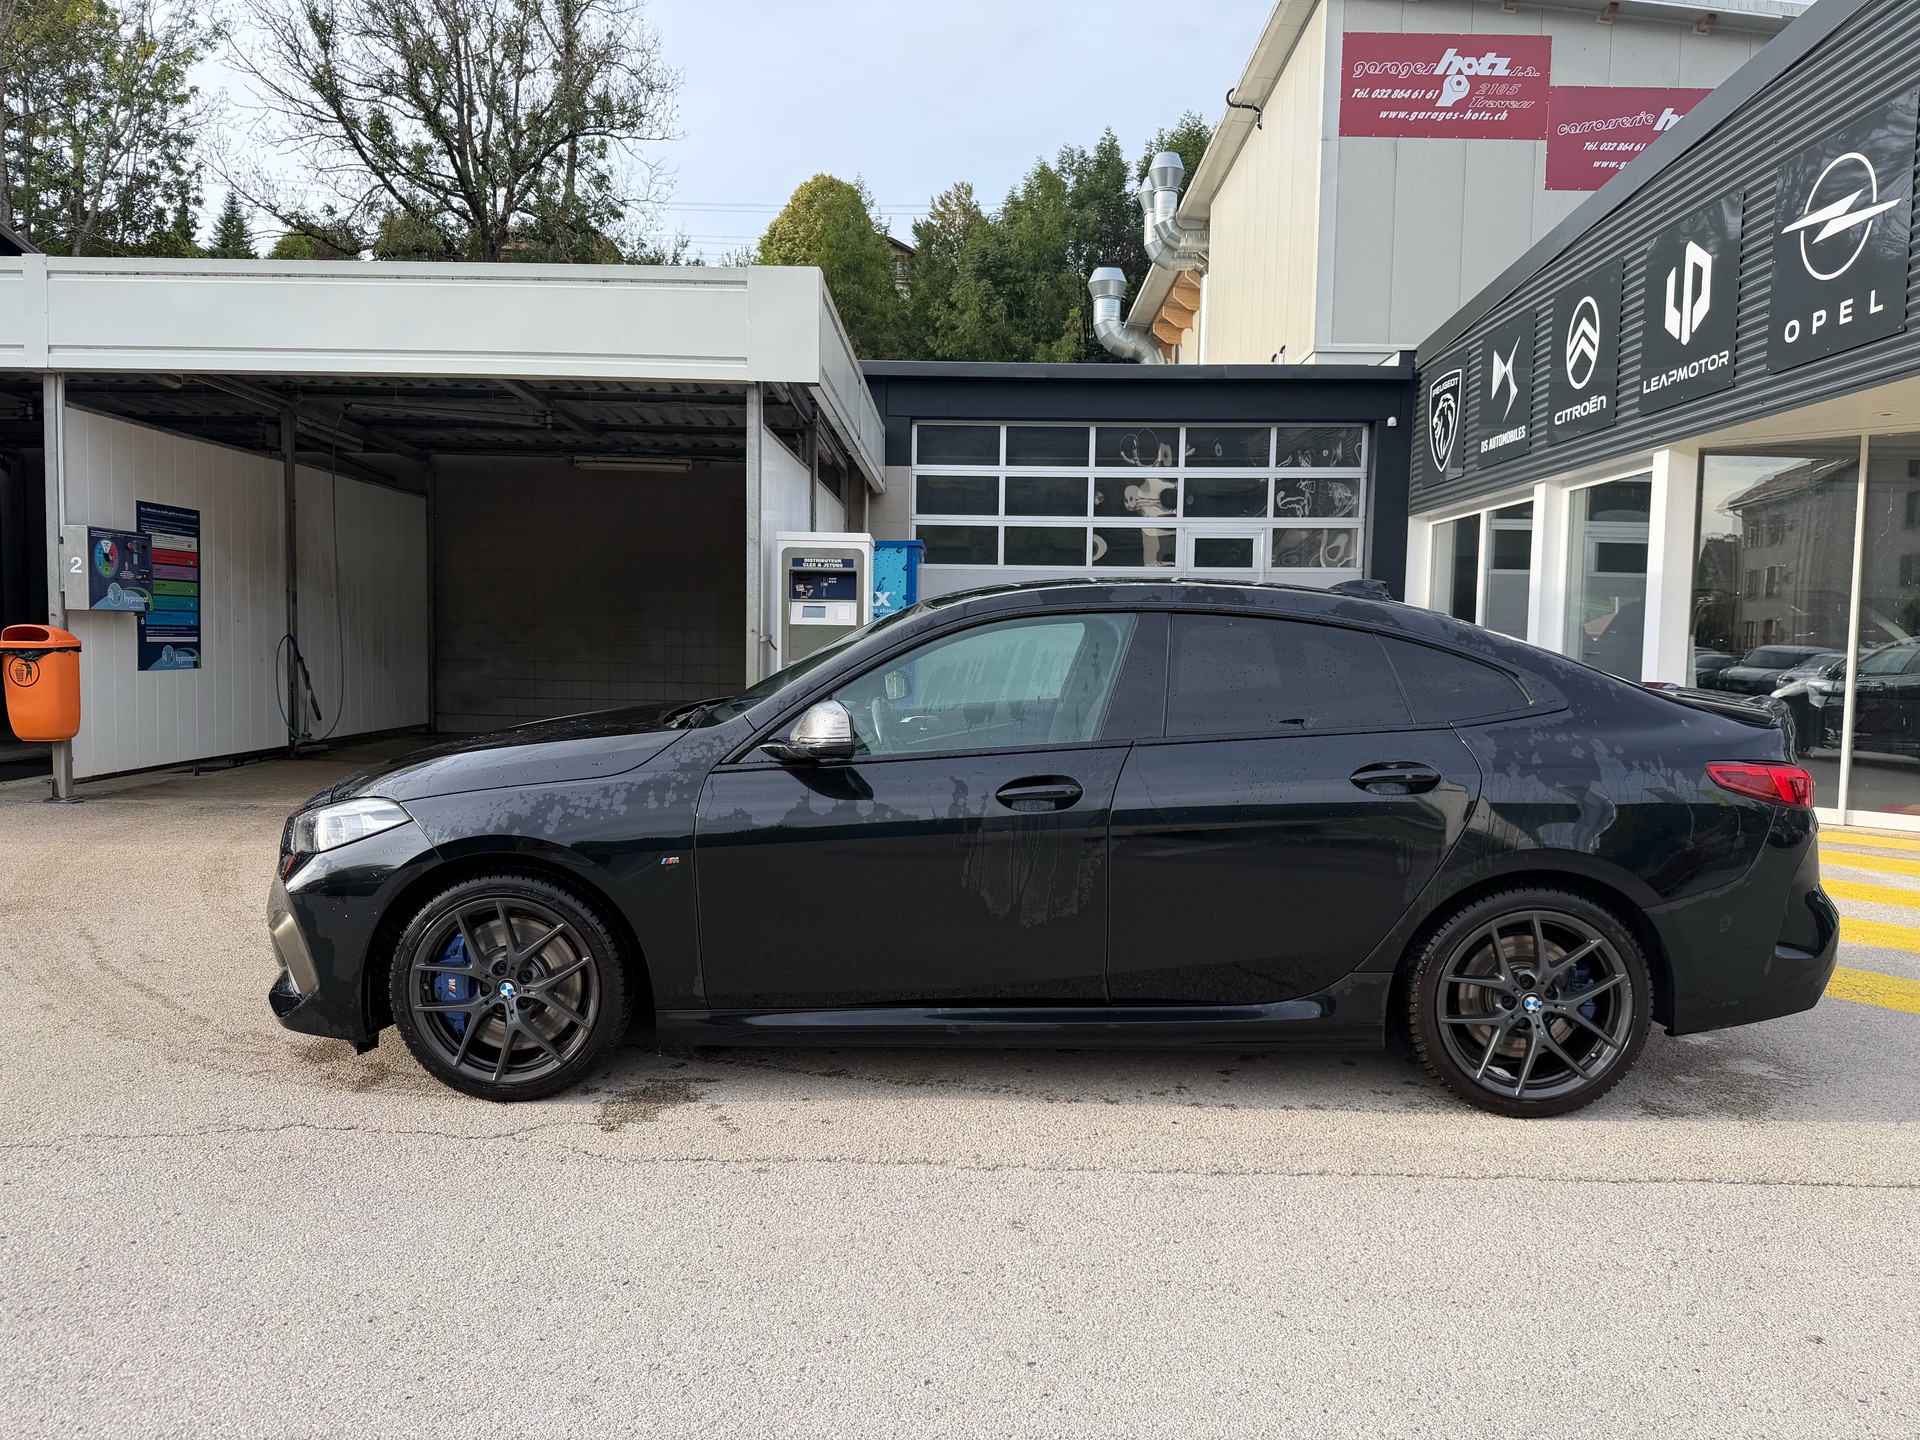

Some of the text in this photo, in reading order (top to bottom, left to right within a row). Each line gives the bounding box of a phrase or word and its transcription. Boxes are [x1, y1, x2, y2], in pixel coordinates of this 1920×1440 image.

[1352, 48, 1541, 79] garages hotz s.a.
[1352, 88, 1440, 100] Tél. 032 864 61 61
[1475, 83, 1521, 95] 2105
[1469, 96, 1535, 108] Travers
[1378, 109, 1508, 121] www.garages-hotz.ch
[1557, 111, 1655, 136] carrosserie
[1583, 141, 1647, 152] Tél. 032 864 61
[1592, 161, 1631, 170] www.g
[1784, 289, 1884, 344] OPEL
[1642, 350, 1729, 395] LEAPMOTOR
[1432, 377, 1459, 398] PEUGEOT
[1554, 395, 1607, 426] CITROËN
[1480, 425, 1526, 454] DS AUTOMOBILES
[69, 556, 83, 574] 2
[140, 617, 146, 625] 6
